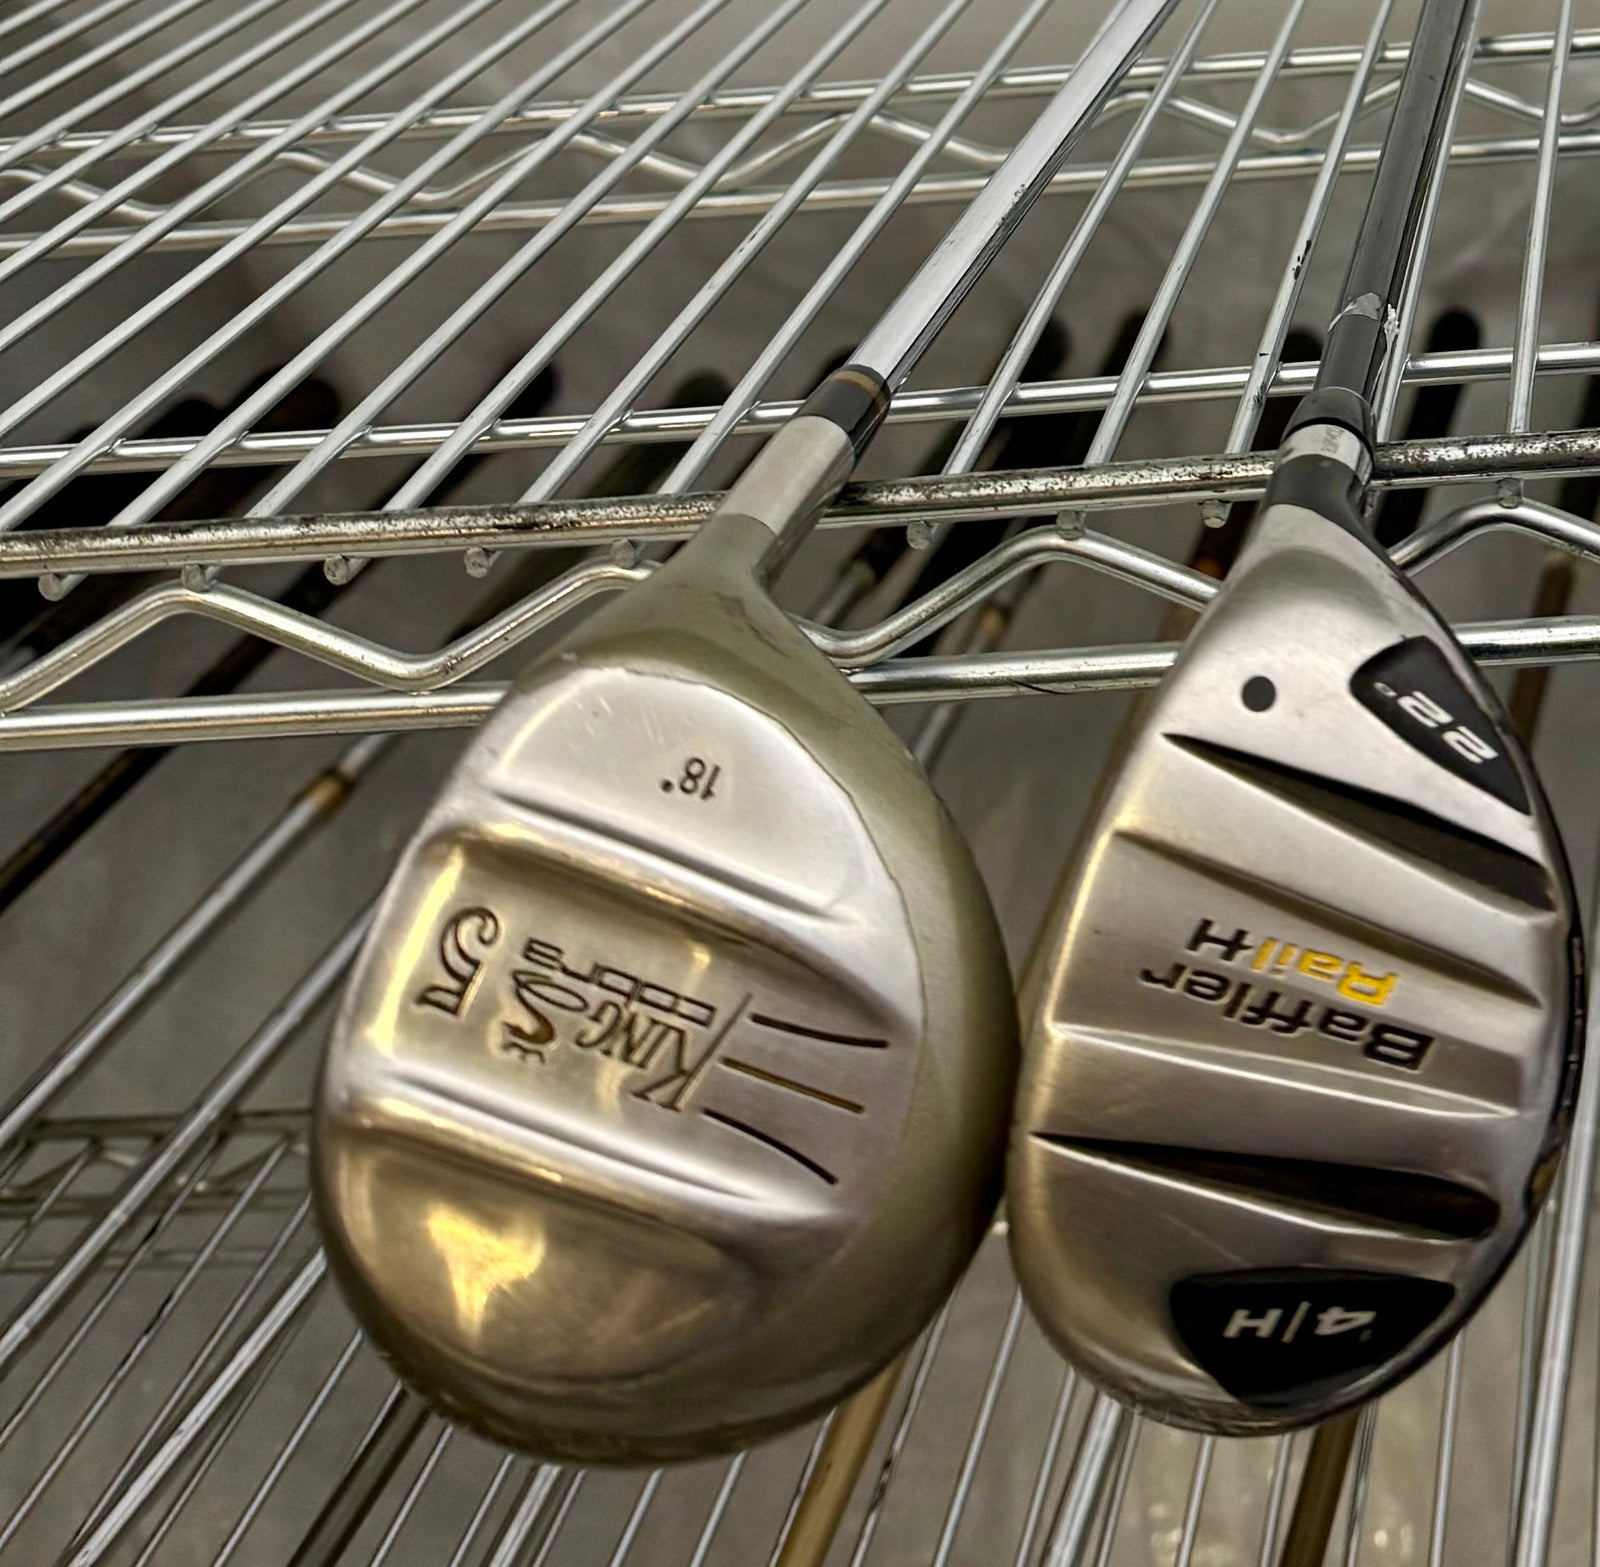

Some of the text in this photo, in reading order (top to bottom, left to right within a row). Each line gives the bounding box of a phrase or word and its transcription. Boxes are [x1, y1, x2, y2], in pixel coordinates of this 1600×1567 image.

[415, 906, 499, 1017] 5
[523, 938, 717, 1027] cobra
[1138, 963, 1435, 1070] Baffler
